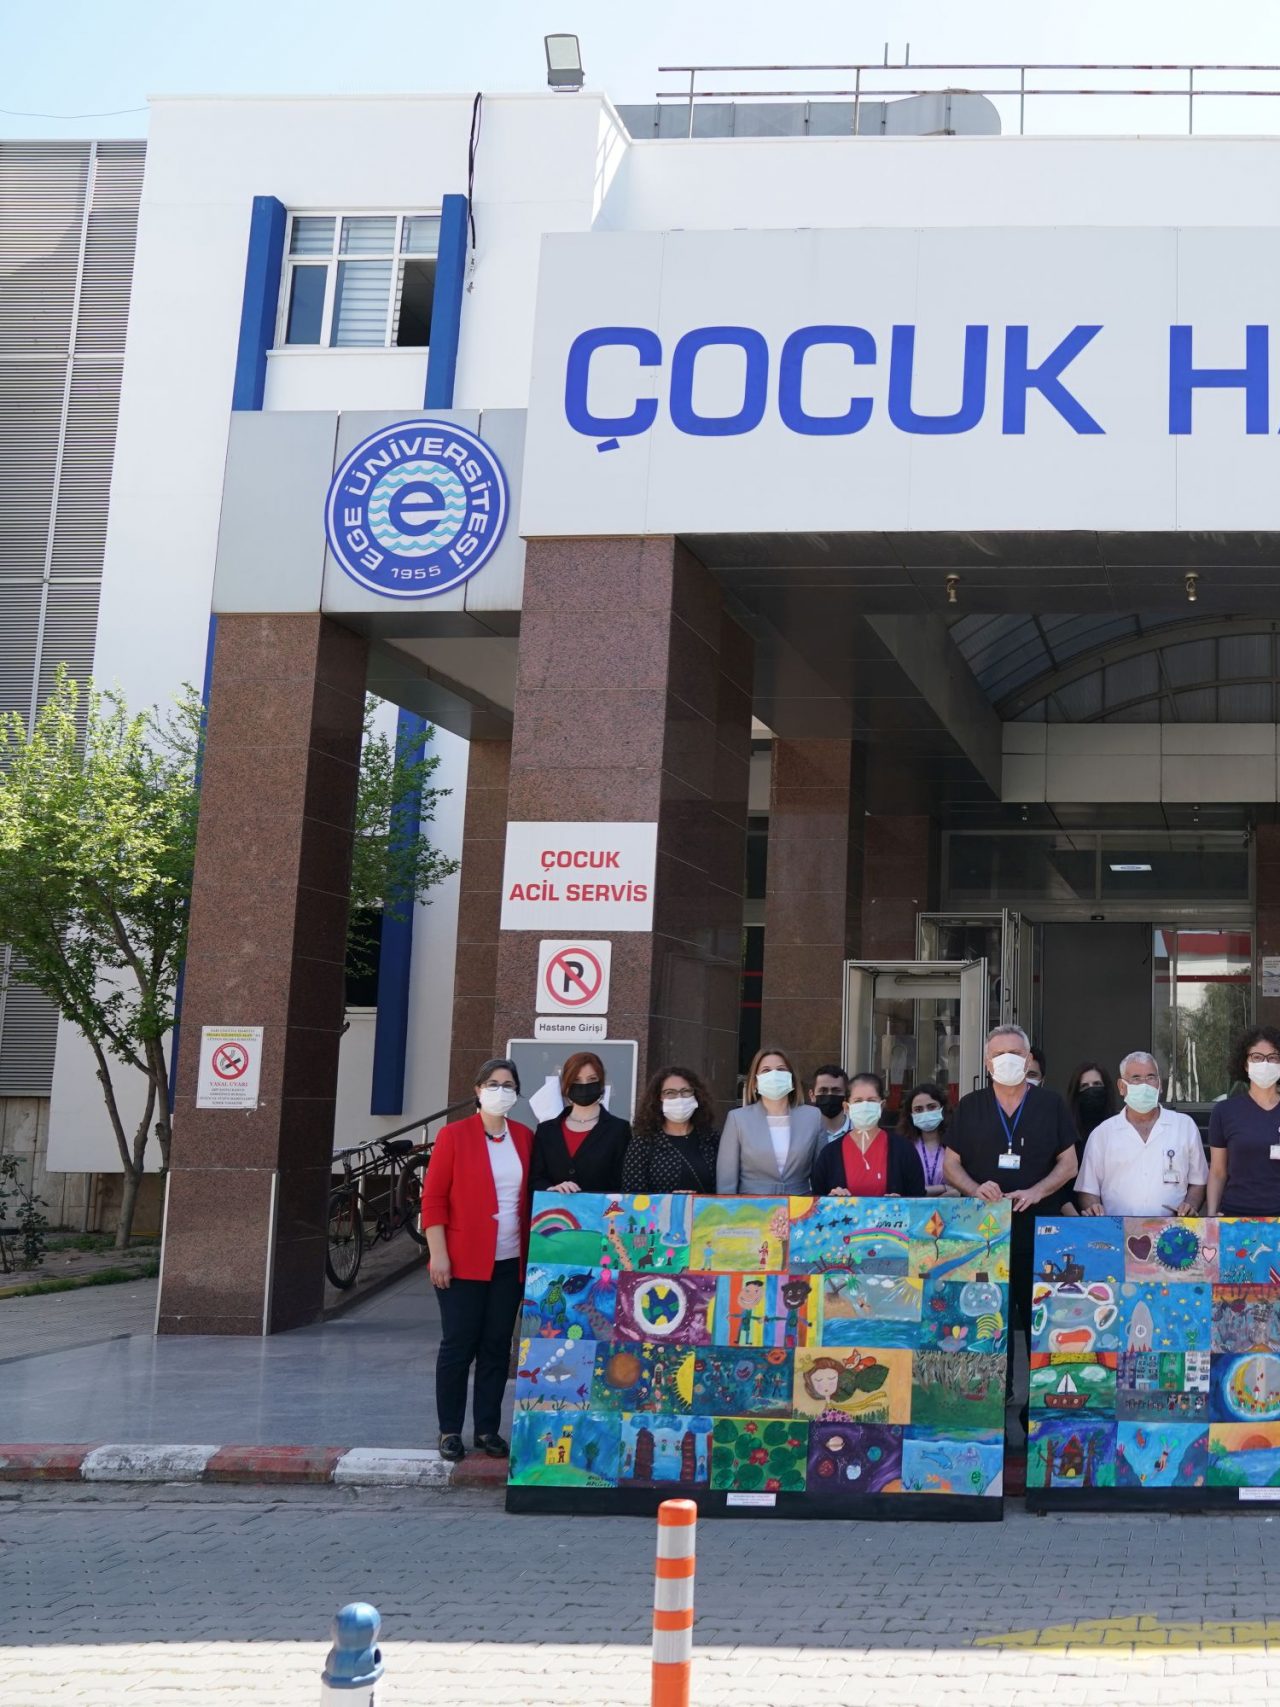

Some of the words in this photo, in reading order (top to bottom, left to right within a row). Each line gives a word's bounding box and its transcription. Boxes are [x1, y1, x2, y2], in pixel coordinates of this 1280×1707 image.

[565, 325, 1107, 453] ÇOCUK
[344, 437, 492, 569] ÜNİVERSİTESİ
[344, 507, 384, 571] EGE
[391, 565, 442, 580] 1955
[540, 850, 621, 873] ÇOCUK
[509, 879, 560, 901] ACİL
[566, 880, 649, 902] SERVİS
[539, 1023, 576, 1032] Hastane
[578, 1023, 603, 1035] Girişi
